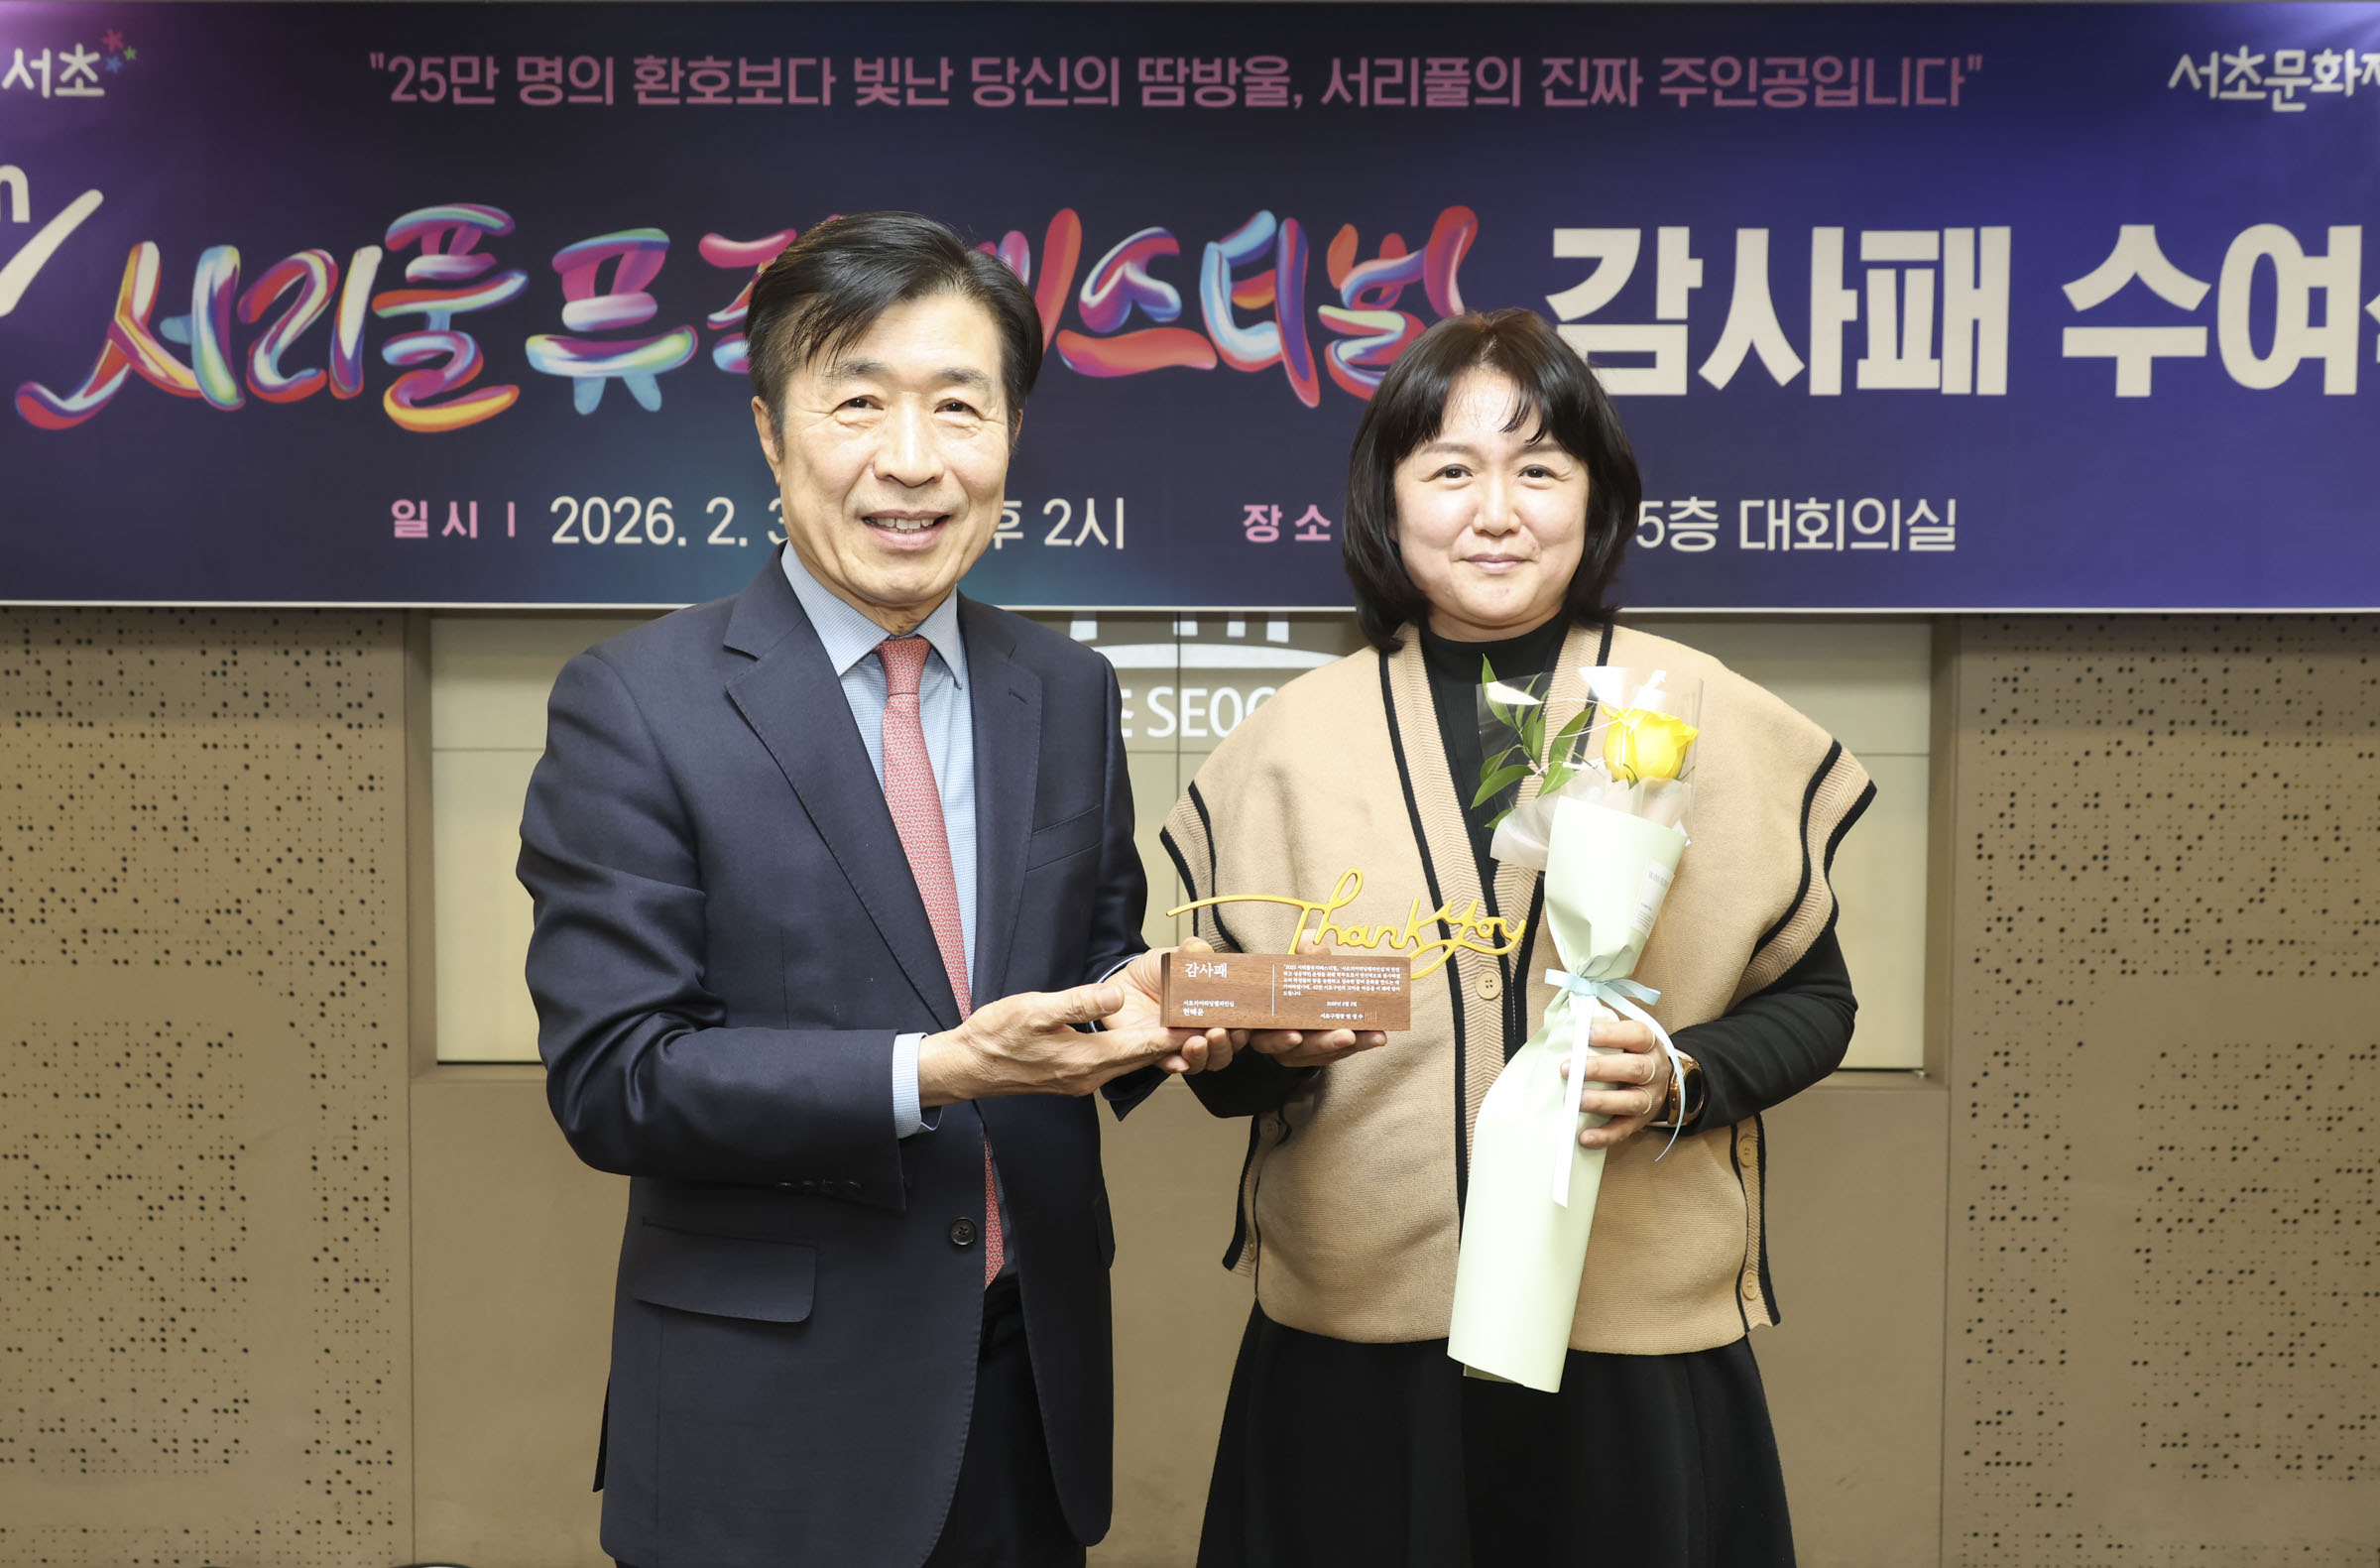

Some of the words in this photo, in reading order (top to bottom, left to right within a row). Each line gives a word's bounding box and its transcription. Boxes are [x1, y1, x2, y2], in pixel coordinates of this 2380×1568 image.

[2, 43, 106, 99] 서초
[368, 54, 501, 106] "25만
[517, 56, 617, 107] 명의
[634, 56, 838, 108] 환호보다
[854, 57, 957, 108] 빛난
[971, 57, 1121, 108] 당신의
[1137, 56, 1304, 109] 땀방울,
[1321, 57, 1522, 108] 서리풀의
[1541, 57, 1645, 108] 진짜
[1659, 55, 1983, 108] 주인공입니다"
[1545, 226, 2012, 397] 감사패
[2062, 223, 2380, 399] 수여
[550, 496, 688, 548] 2026.
[706, 496, 749, 548] 2.
[1042, 498, 1127, 551] 2시
[1636, 497, 1722, 552] 5층
[1739, 497, 1959, 552] 대회의실
[1184, 962, 1229, 979] 감사패
